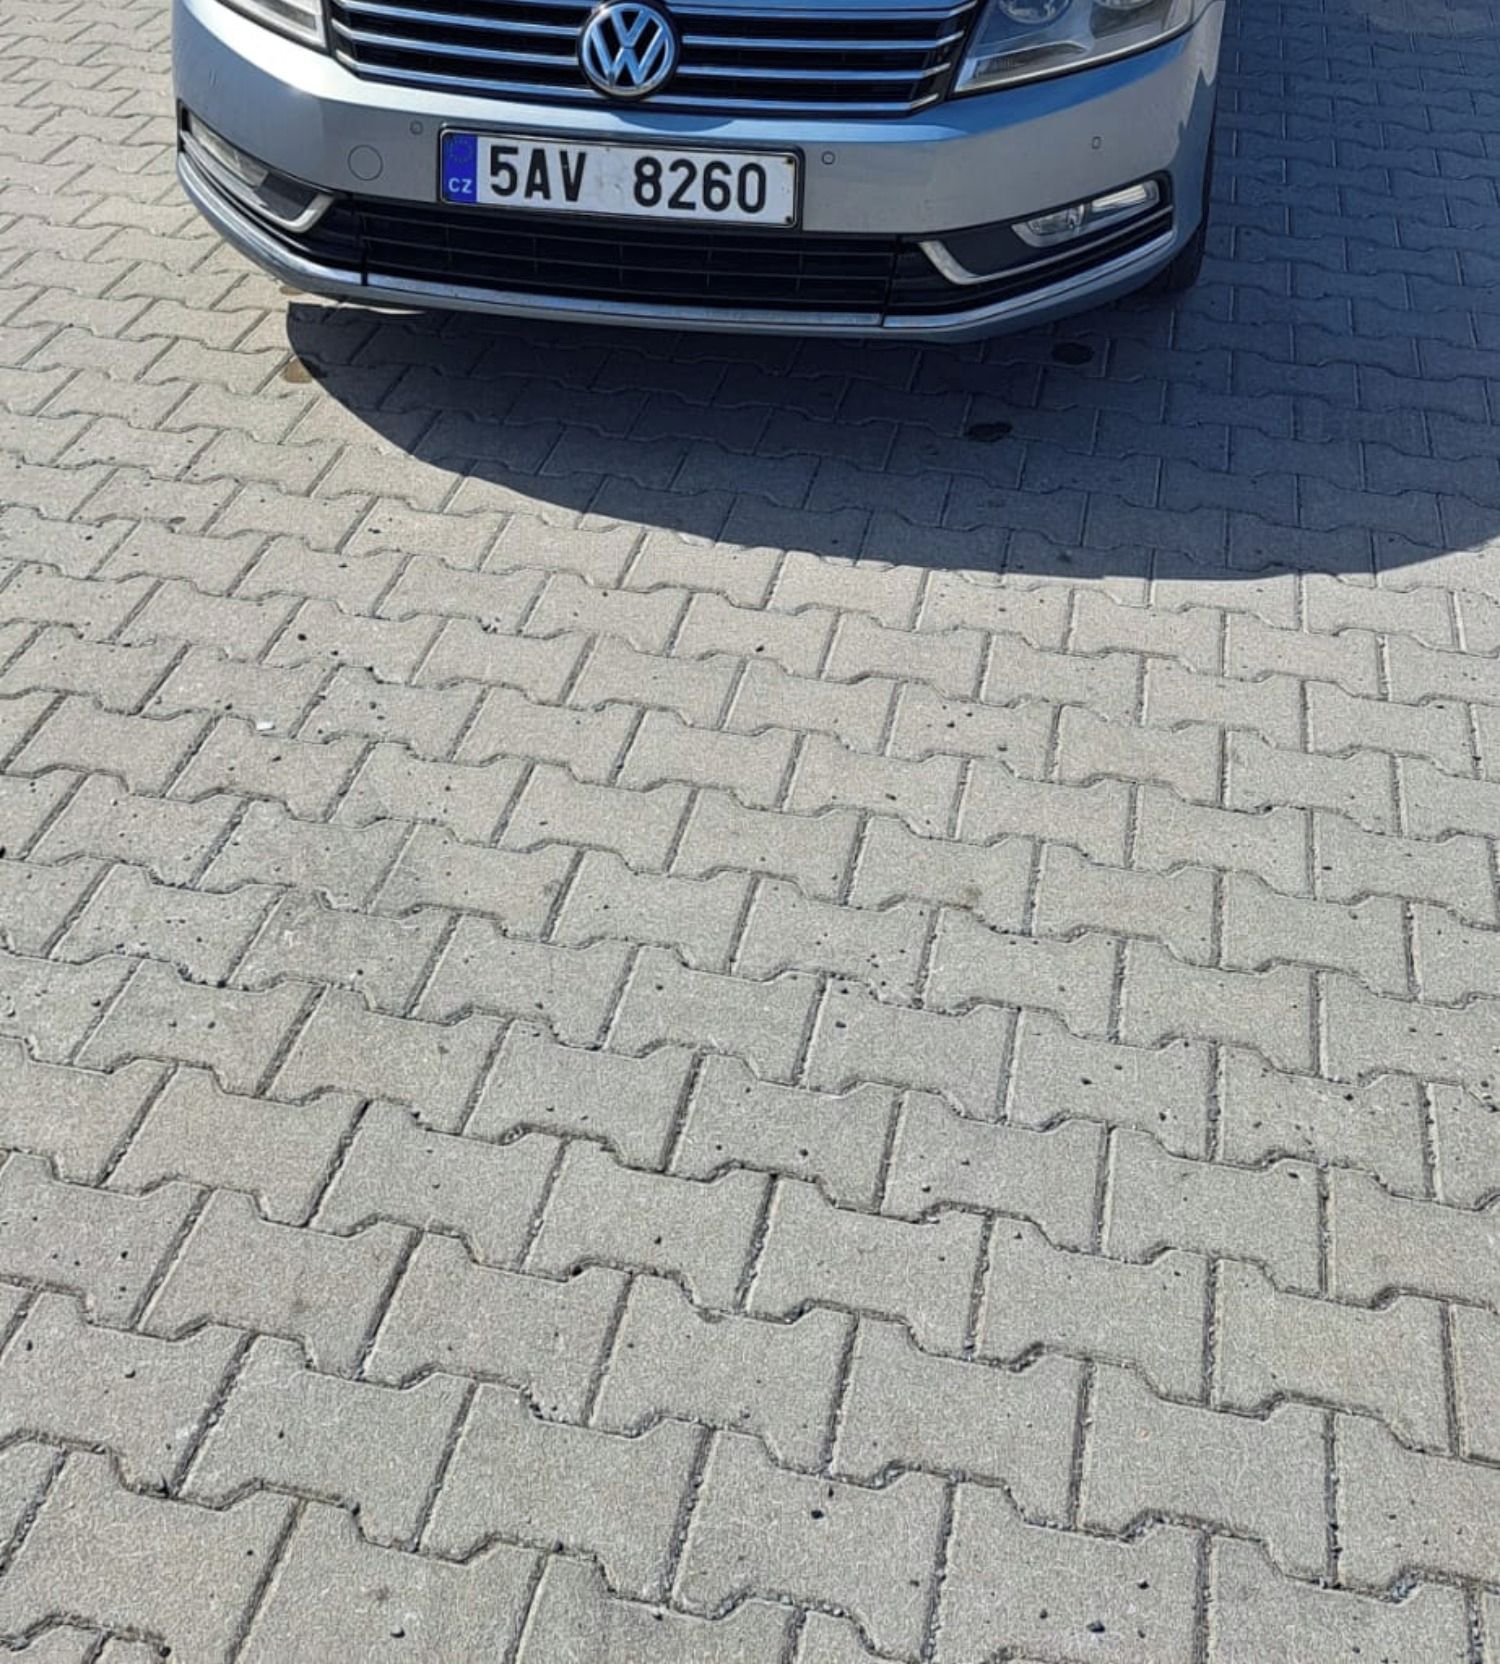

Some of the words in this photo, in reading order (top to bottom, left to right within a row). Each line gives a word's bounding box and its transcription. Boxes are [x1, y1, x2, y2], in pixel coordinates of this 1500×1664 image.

[582, 2, 675, 96] VW
[448, 177, 473, 194] CZ
[489, 145, 587, 202] 5AV
[633, 156, 767, 214] 8260
